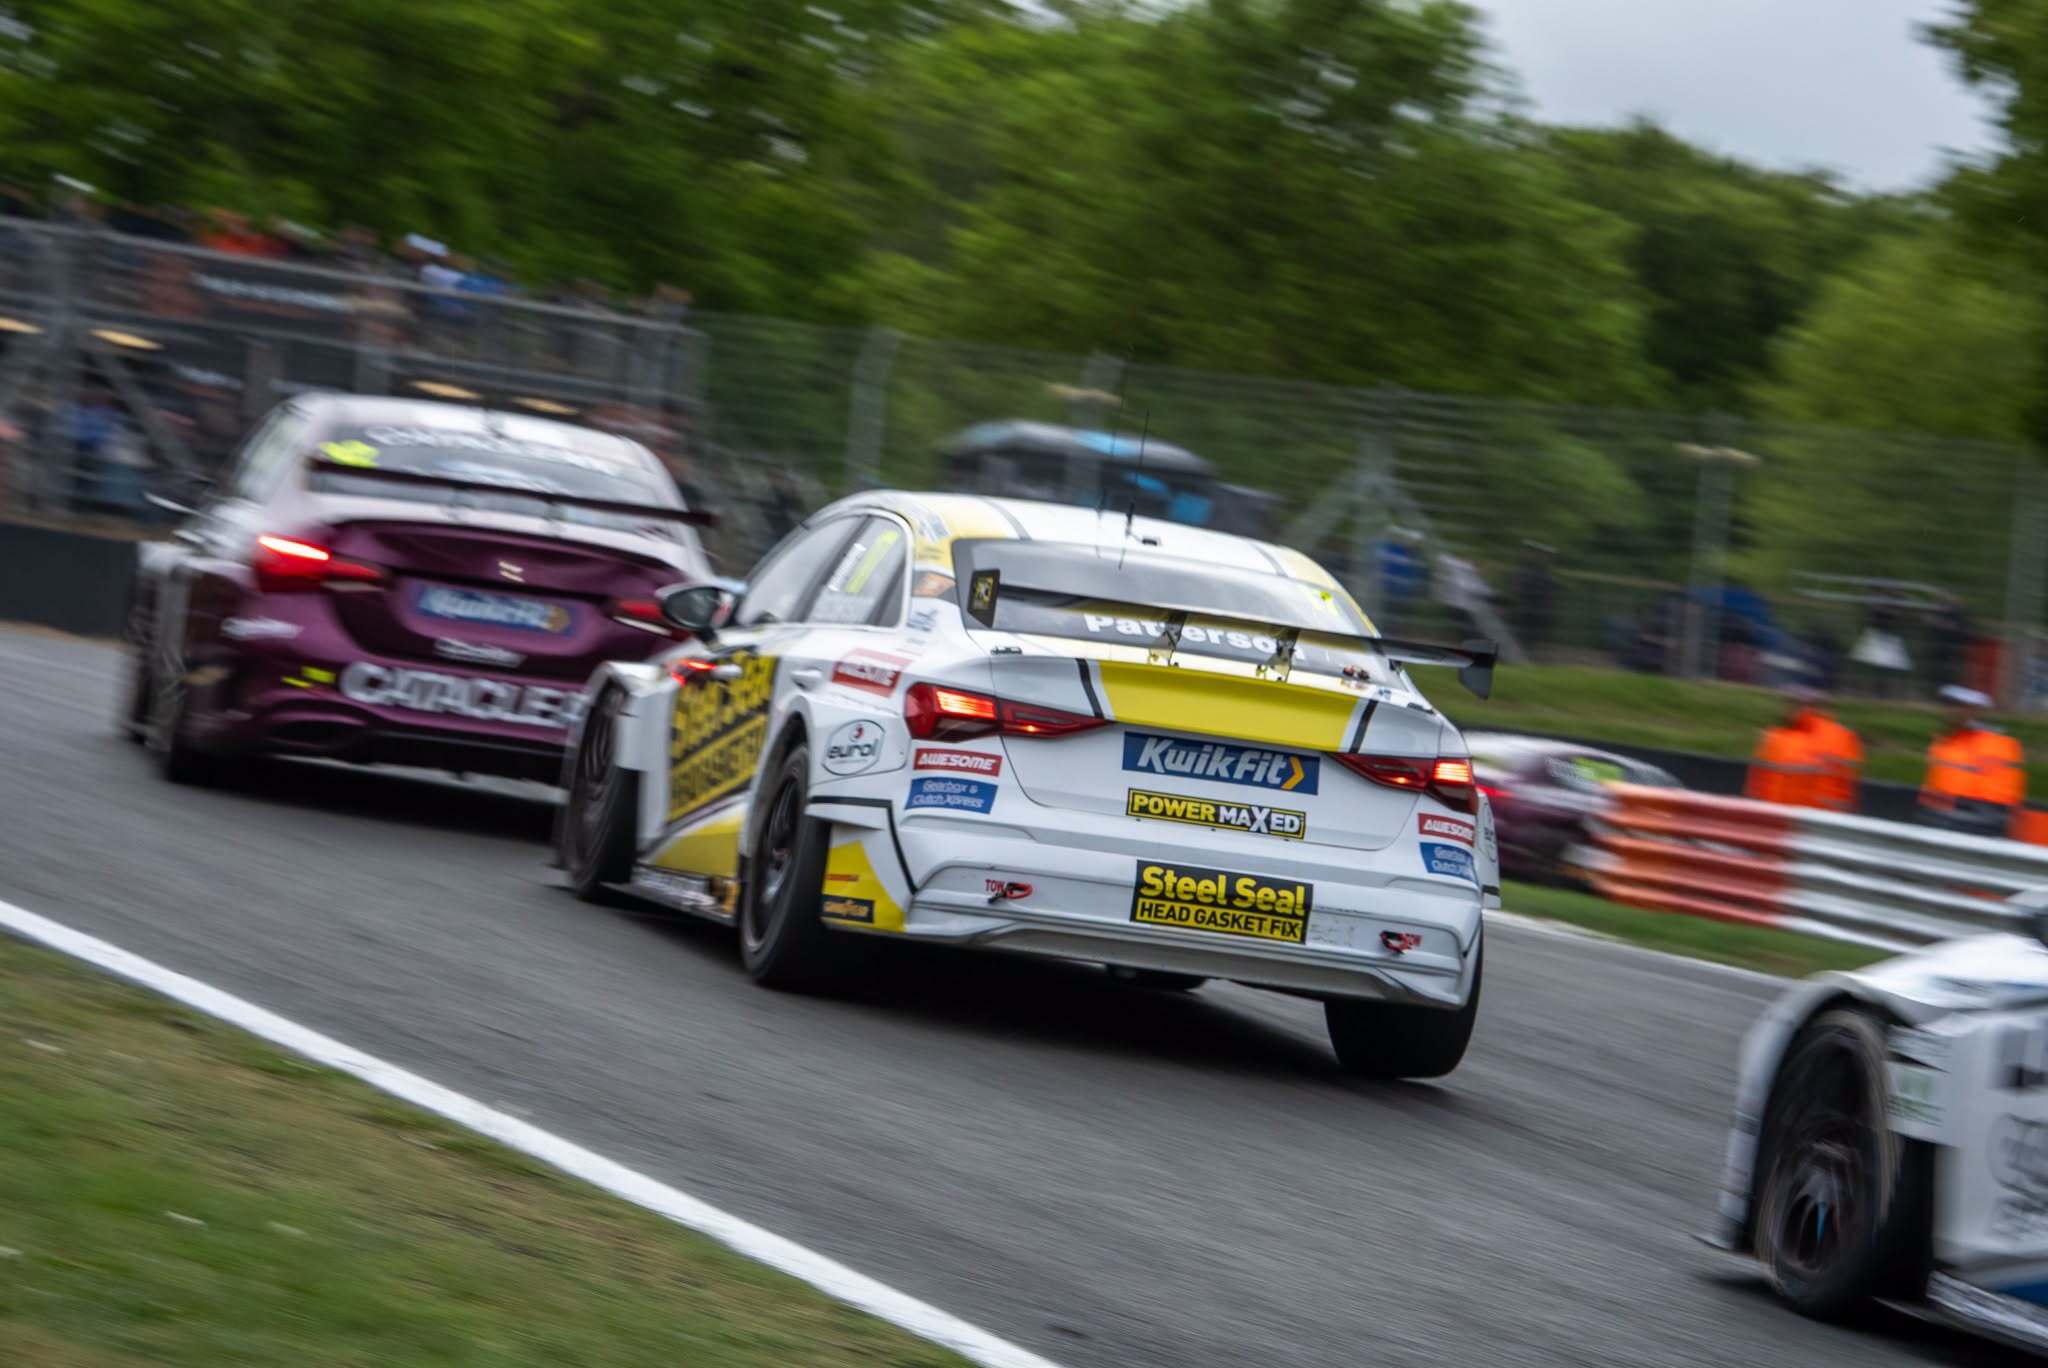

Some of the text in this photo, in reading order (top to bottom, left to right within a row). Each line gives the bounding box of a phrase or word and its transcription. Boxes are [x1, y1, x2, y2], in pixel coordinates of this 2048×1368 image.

[827, 738, 879, 760] eurol
[917, 752, 996, 771] AWESOME
[1132, 794, 1300, 834] POWER MAXED
[1140, 865, 1306, 917] Steel Seal
[1139, 901, 1300, 939] HEAD GASKET FIX
